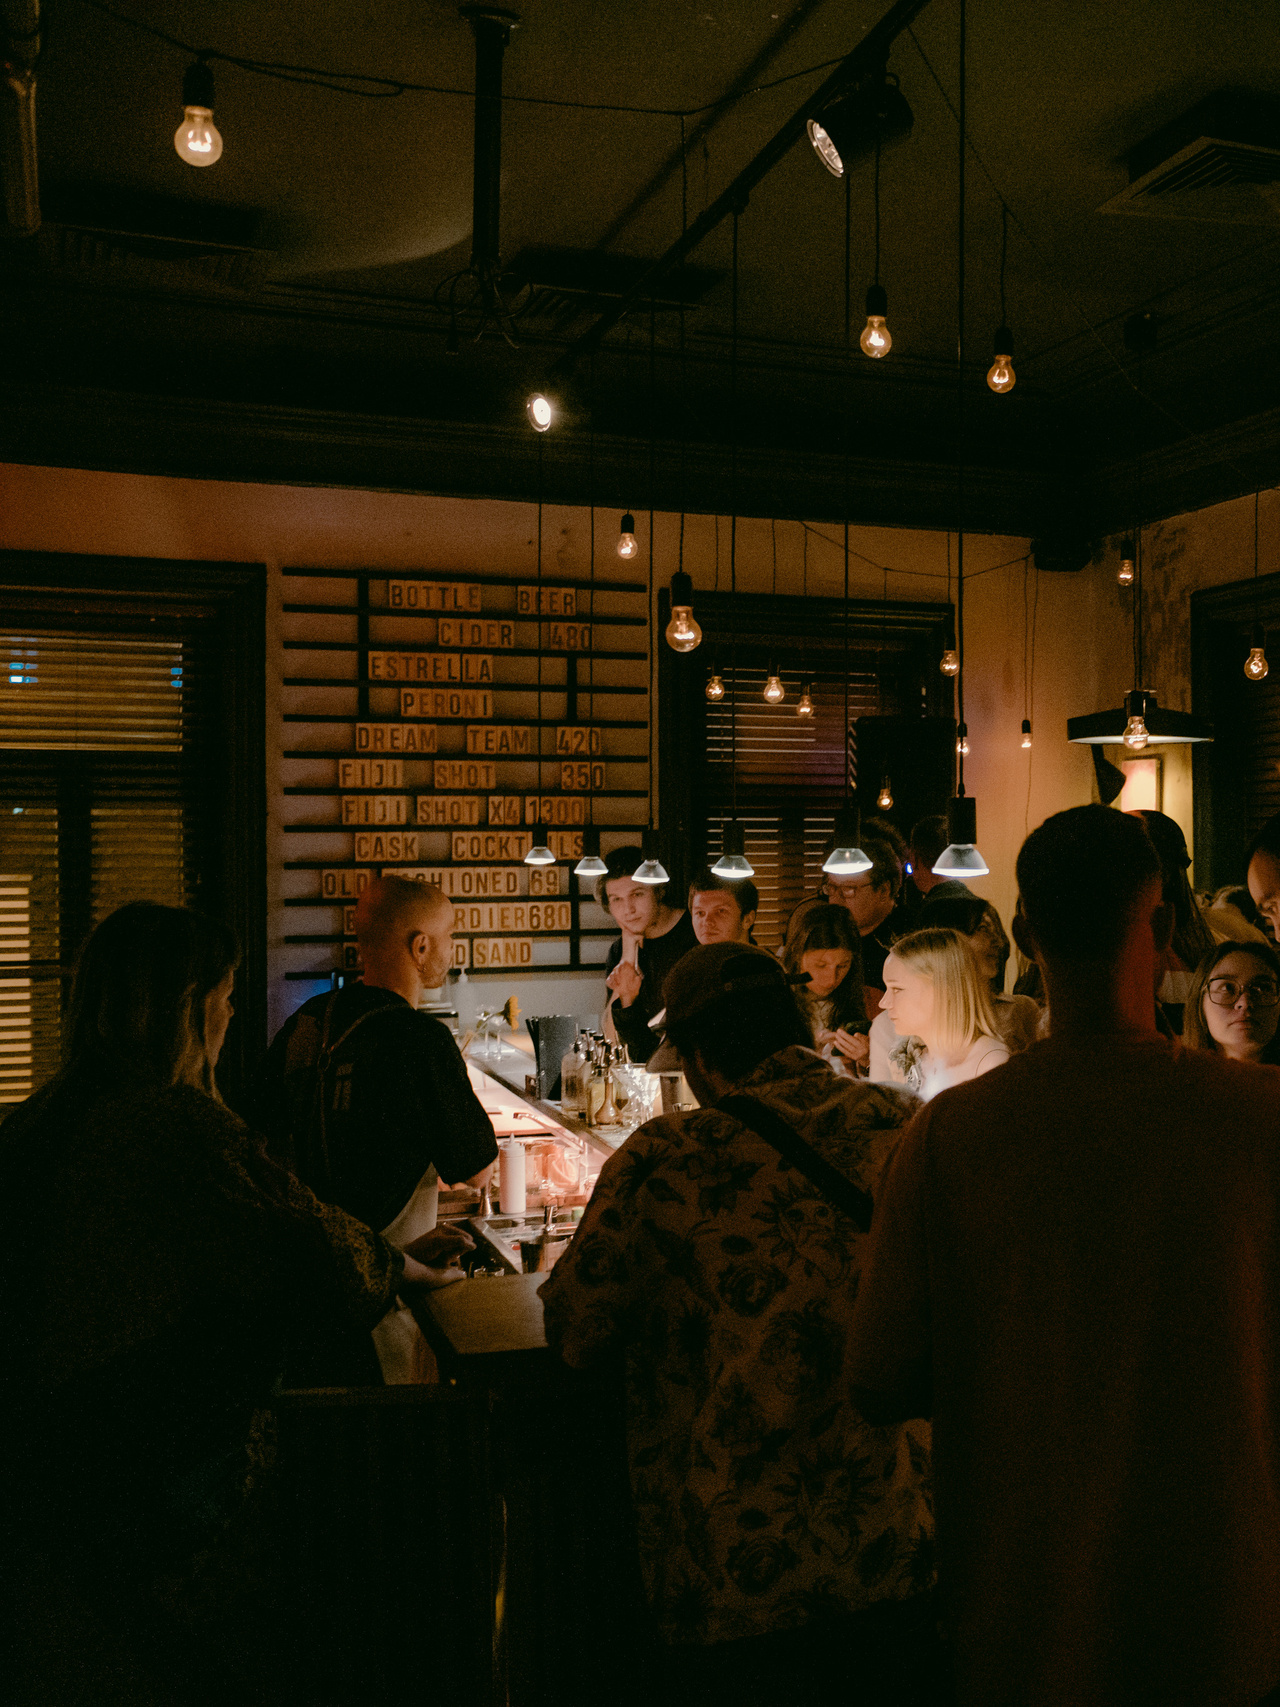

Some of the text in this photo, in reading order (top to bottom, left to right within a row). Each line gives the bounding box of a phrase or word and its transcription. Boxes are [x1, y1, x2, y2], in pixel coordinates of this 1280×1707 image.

[391, 584, 575, 613] BOTTLE BEER
[440, 623, 592, 650] CIDER 480
[371, 656, 492, 681] ESTRELLA
[403, 693, 488, 716] PERONI
[358, 726, 599, 754] DREAM TEAM 420
[340, 763, 605, 790] FIJI SHOT 350
[344, 798, 583, 824] FIJI SHOT X4 1300
[356, 834, 583, 860] CASK COCKTILS
[324, 872, 369, 896] OLD
[475, 942, 531, 965] SAND
